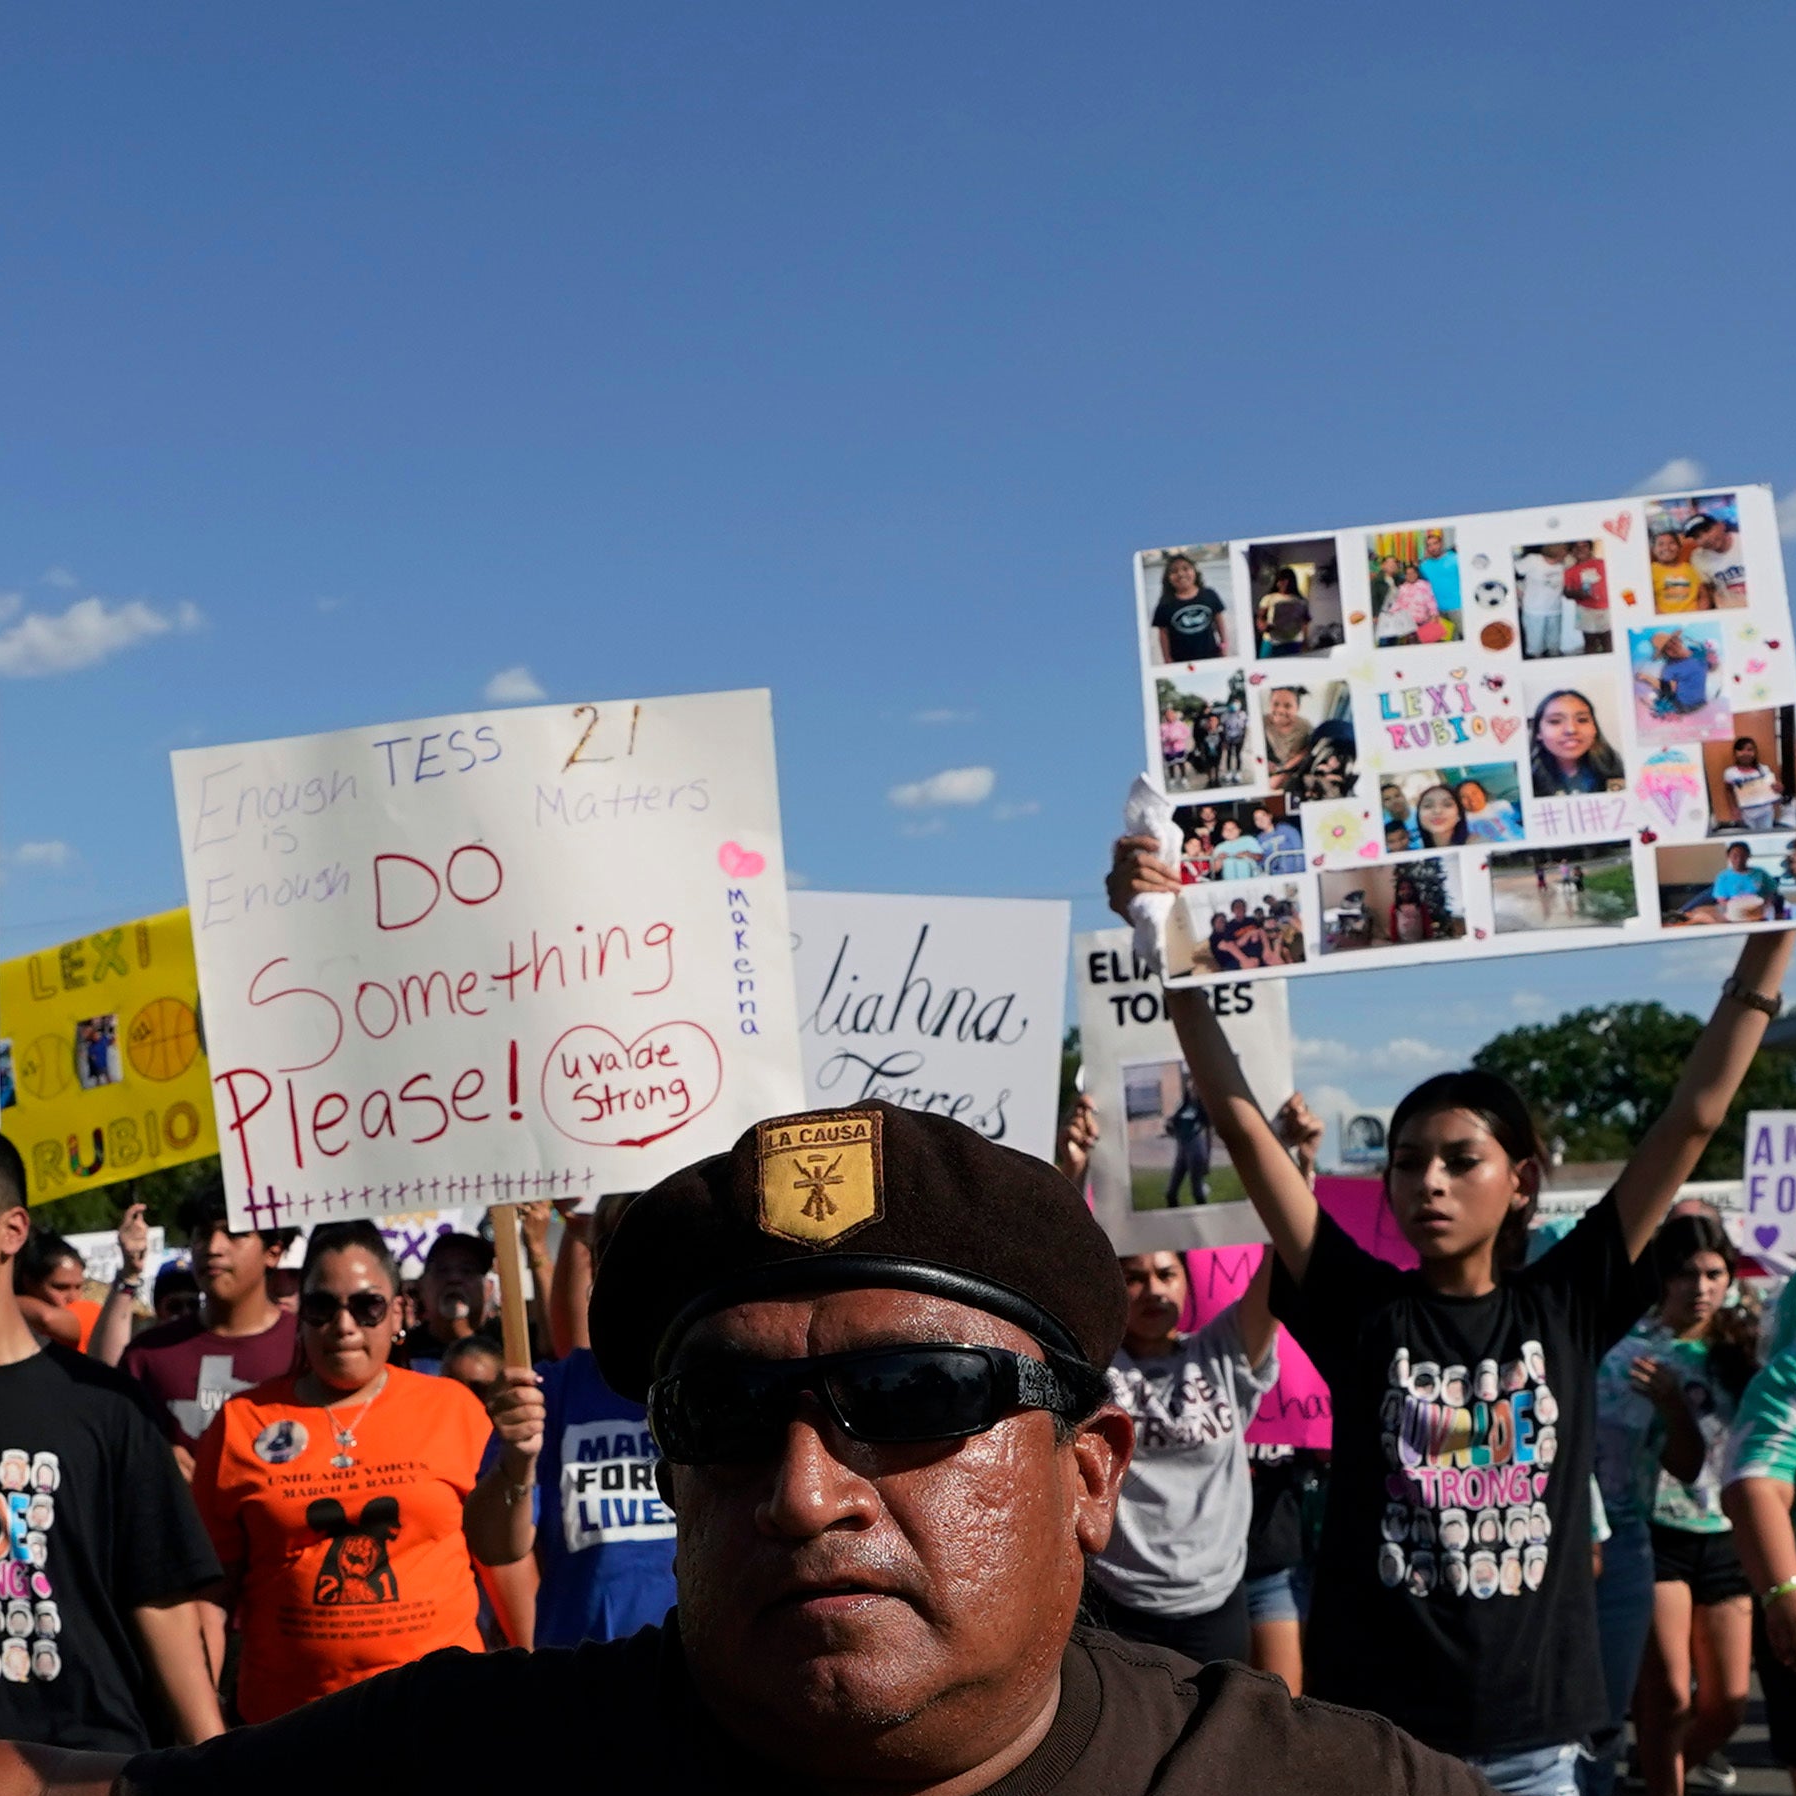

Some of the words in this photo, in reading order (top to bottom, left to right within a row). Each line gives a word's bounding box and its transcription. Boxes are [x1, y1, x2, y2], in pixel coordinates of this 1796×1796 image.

[1379, 683, 1476, 721] LEXI
[1386, 715, 1486, 751] RUBIO
[371, 725, 504, 787] TESS
[561, 703, 642, 774] 21
[191, 762, 360, 854] Enough
[534, 776, 712, 829] Matters
[261, 820, 298, 855] is
[199, 862, 352, 931] Enough
[372, 843, 503, 931] DO
[27, 920, 153, 1002] LEXI
[790, 922, 1029, 1045] liahna
[248, 922, 676, 1073] Something
[1108, 980, 1255, 1027] TOES
[212, 1039, 526, 1188] Please!
[571, 1073, 693, 1125] Strong
[31, 1100, 202, 1193] RUBIO
[767, 1131, 792, 1148] LA
[799, 1123, 867, 1143] CAUSA
[1398, 1390, 1538, 1467] UVALDE
[282, 1483, 342, 1501] MARCH
[366, 1475, 418, 1490] RALLY
[576, 1463, 654, 1493] FOR
[578, 1497, 676, 1532] LIVE
